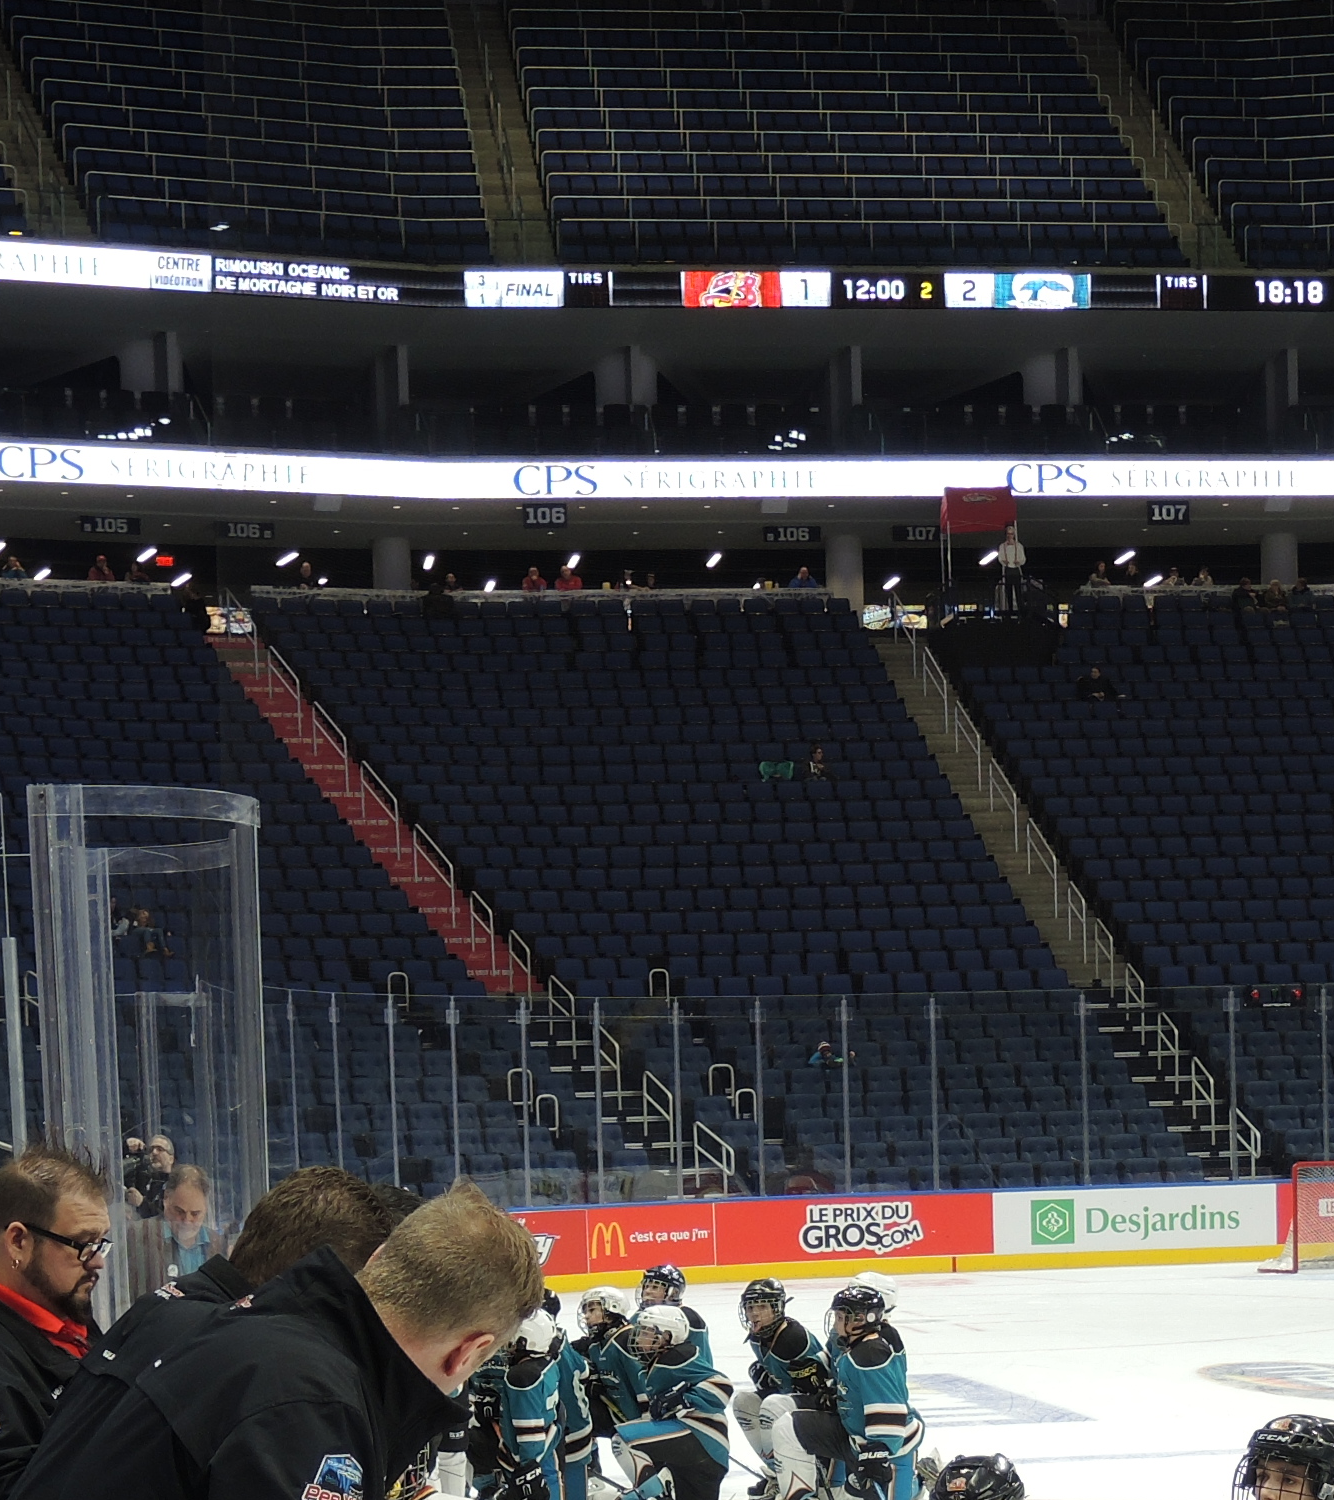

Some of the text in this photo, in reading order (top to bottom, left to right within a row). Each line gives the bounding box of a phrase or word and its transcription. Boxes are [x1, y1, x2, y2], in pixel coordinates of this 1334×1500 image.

[158, 256, 201, 272] CENTRE
[215, 258, 350, 280] RIMOUSKI OCEANIC
[216, 276, 399, 301] DE MORTAGNE NOIR ET OR
[568, 272, 603, 285] TIRS
[843, 278, 905, 299] 12:00
[1165, 275, 1198, 288] TIRS
[505, 282, 554, 298] FINAL
[799, 278, 808, 300] 1
[920, 282, 932, 299] 2
[962, 280, 976, 300] 2
[1254, 281, 1324, 303] 18:18
[513, 464, 599, 495] CPS
[1006, 463, 1088, 494] CPS
[526, 503, 567, 526] 106
[1151, 503, 1187, 523] 107
[93, 517, 128, 533] 105
[227, 522, 261, 539] 106
[777, 527, 810, 542] 106
[906, 525, 936, 542] 107
[809, 1203, 910, 1223] LE PRIX DU
[1085, 1203, 1240, 1241] Desjardins
[629, 1230, 654, 1243] c'est
[655, 1232, 668, 1244] ça
[670, 1231, 689, 1243] que
